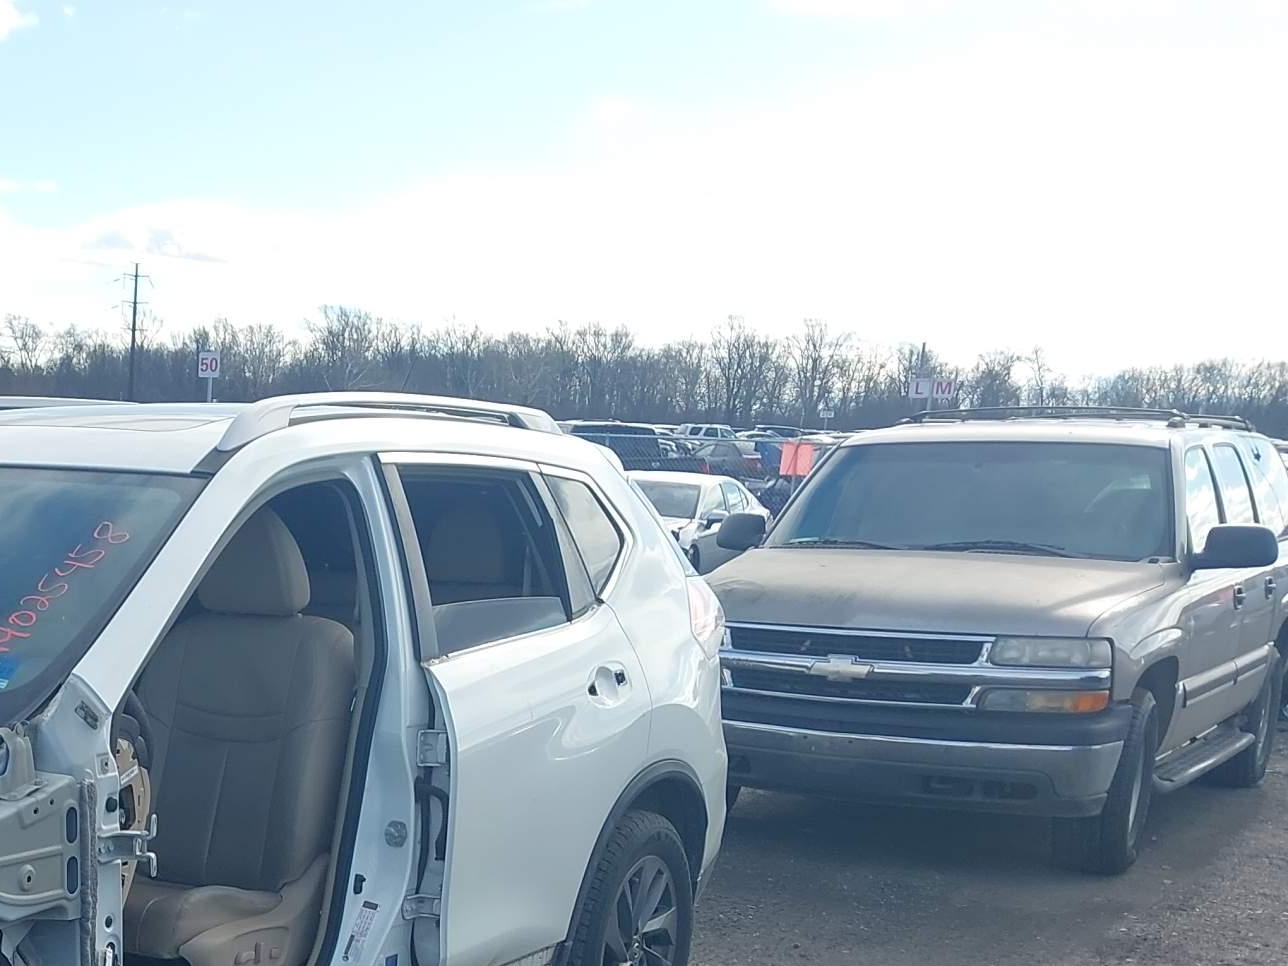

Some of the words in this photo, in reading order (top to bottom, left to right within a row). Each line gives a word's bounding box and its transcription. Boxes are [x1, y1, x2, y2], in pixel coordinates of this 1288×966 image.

[200, 357, 218, 373] 50
[915, 381, 924, 395] L
[935, 381, 953, 395] M
